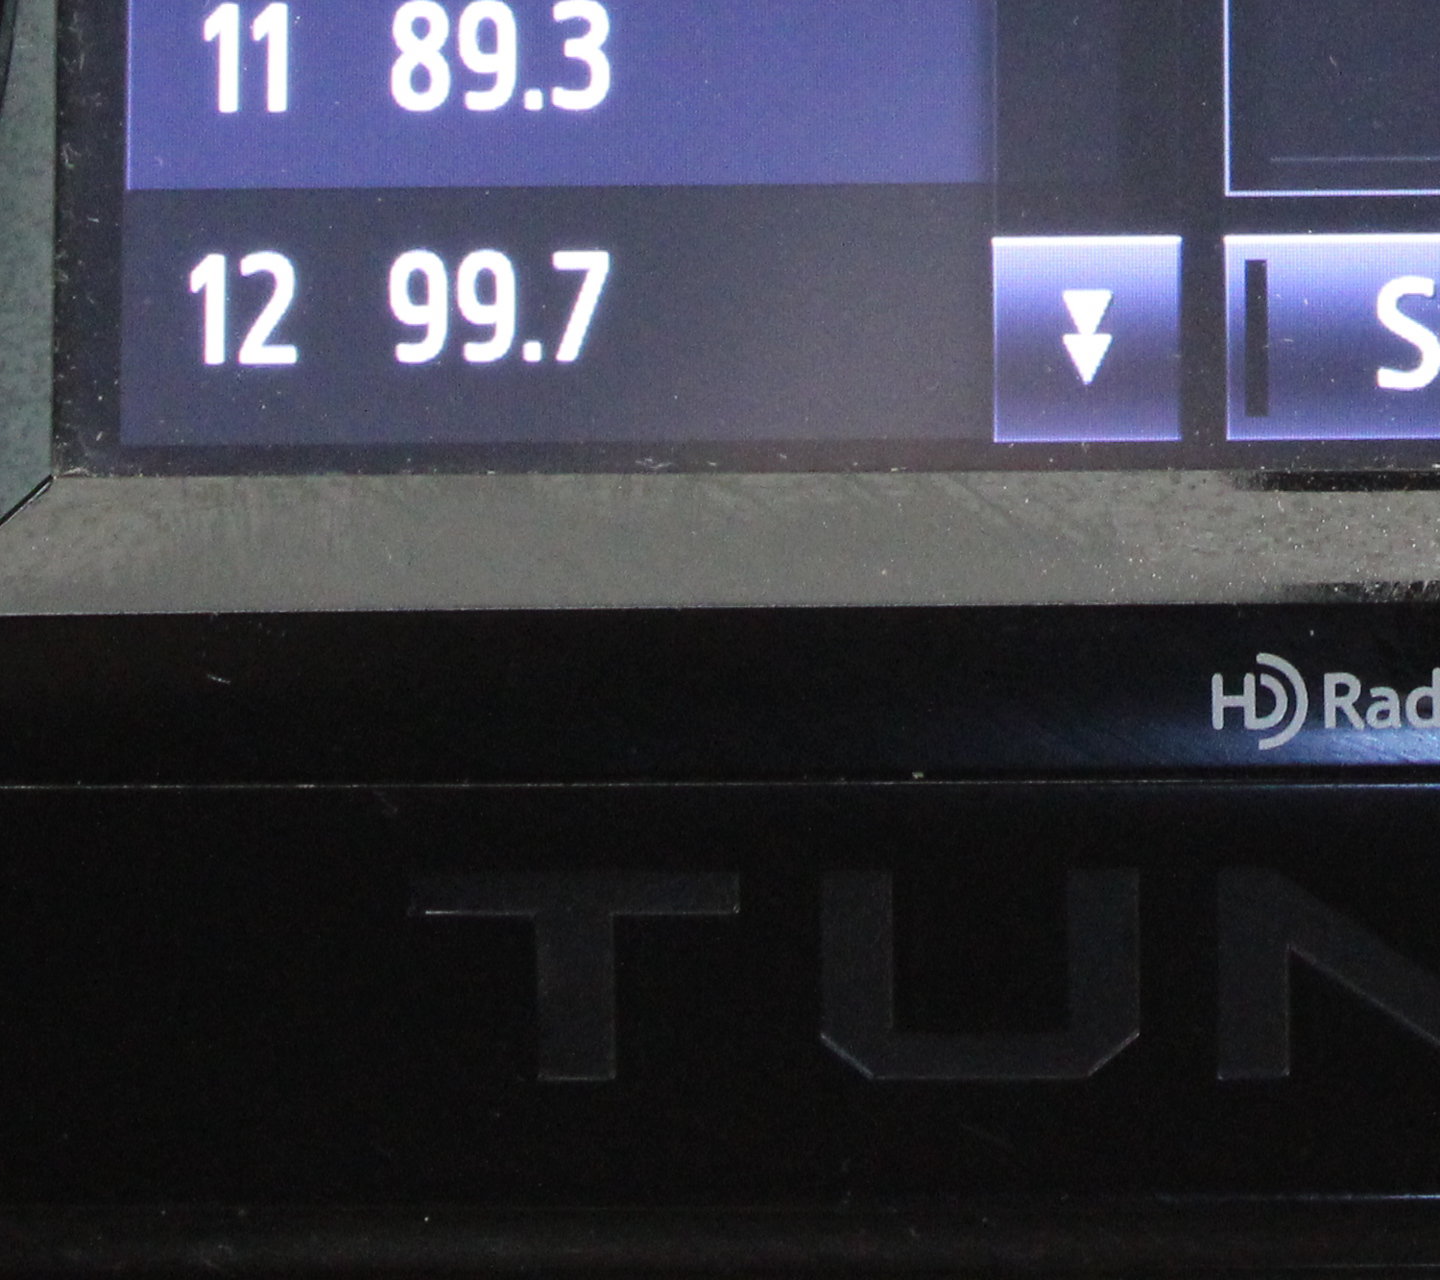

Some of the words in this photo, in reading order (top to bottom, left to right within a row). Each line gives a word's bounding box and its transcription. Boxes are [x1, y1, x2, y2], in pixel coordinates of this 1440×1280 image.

[203, 2, 290, 115] 11
[190, 251, 299, 366] 12
[389, 249, 611, 365] 99.7
